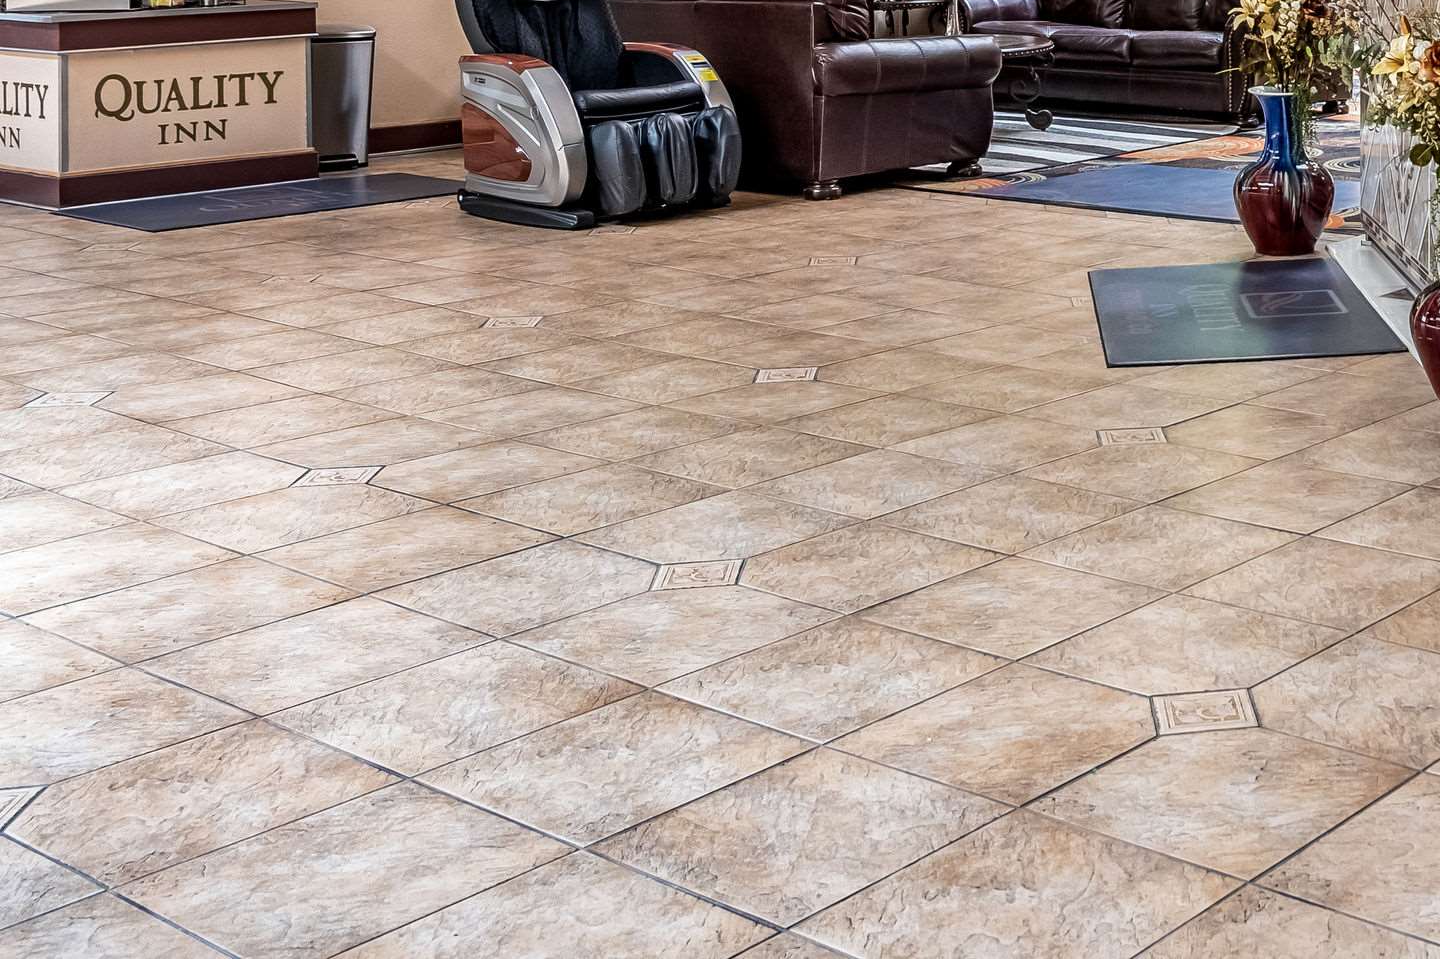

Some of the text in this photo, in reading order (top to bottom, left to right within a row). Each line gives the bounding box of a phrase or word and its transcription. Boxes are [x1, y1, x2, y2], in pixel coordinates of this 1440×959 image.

[0, 81, 49, 119] LITY
[94, 71, 284, 122] QUALITY
[0, 126, 21, 149] NN
[158, 119, 228, 145] INN
